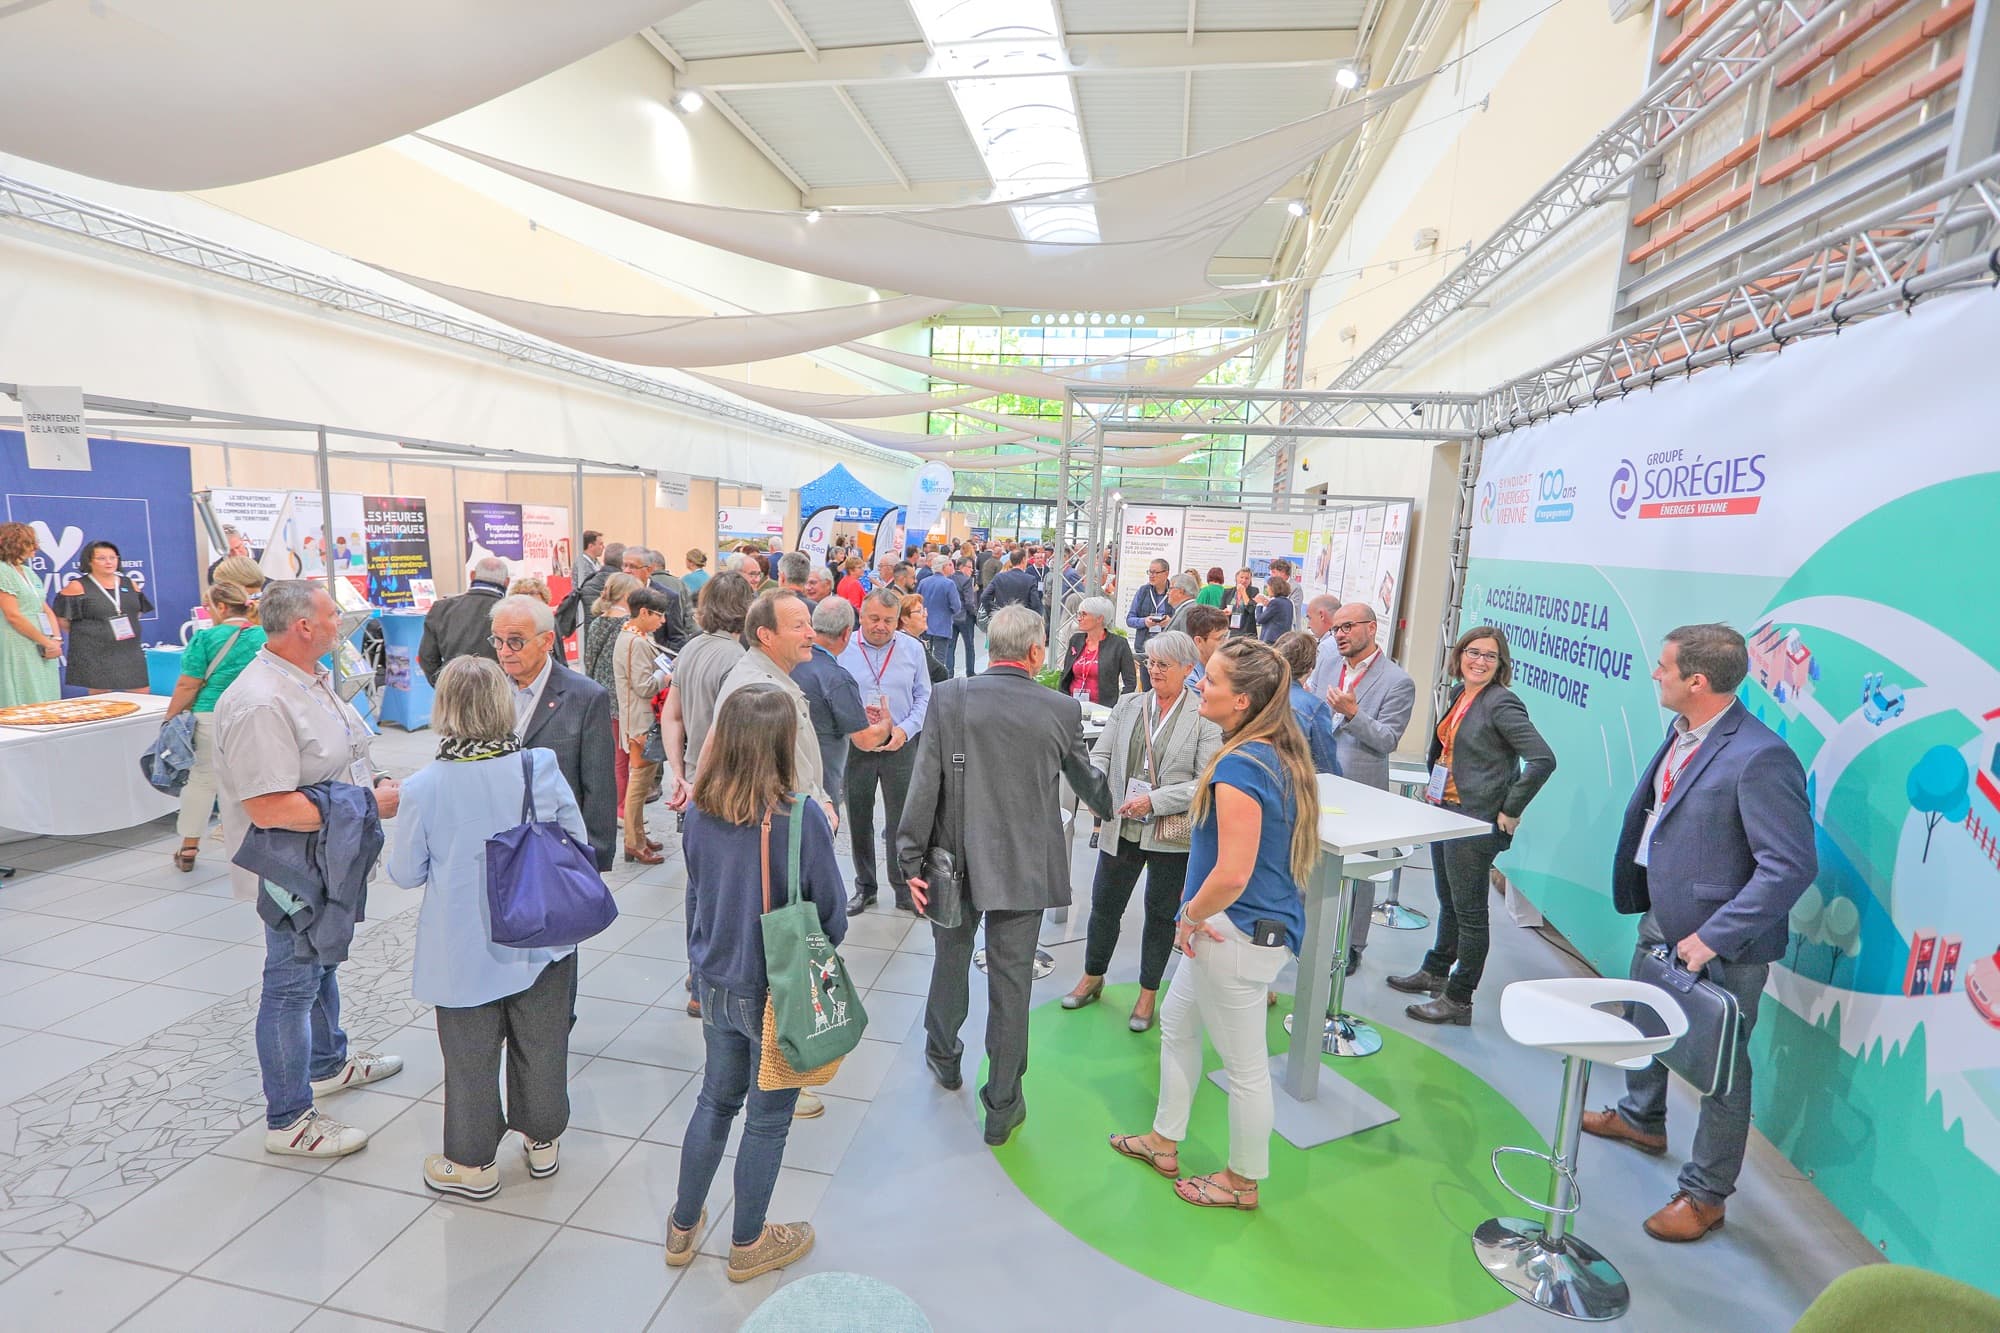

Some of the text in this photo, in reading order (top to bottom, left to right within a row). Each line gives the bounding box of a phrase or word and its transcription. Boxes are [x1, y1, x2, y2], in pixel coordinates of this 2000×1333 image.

[54, 426, 80, 434] VIENNE
[1647, 448, 1684, 466] GROUPE
[1498, 474, 1533, 489] SYNDICAT
[1642, 453, 1766, 500] SORÉGIES
[386, 512, 424, 522] HEURES
[1497, 506, 1527, 524] VIENNE
[1660, 502, 1729, 516] ÉNERGIES VIENNE
[365, 523, 426, 534] NUMÉRIQUES
[1485, 584, 1608, 632] ACCÉLÉRATEURS DE LA
[1539, 626, 1633, 681] ÉNERGÉTIQUE
[1523, 662, 1590, 709] TERRITOIRE
